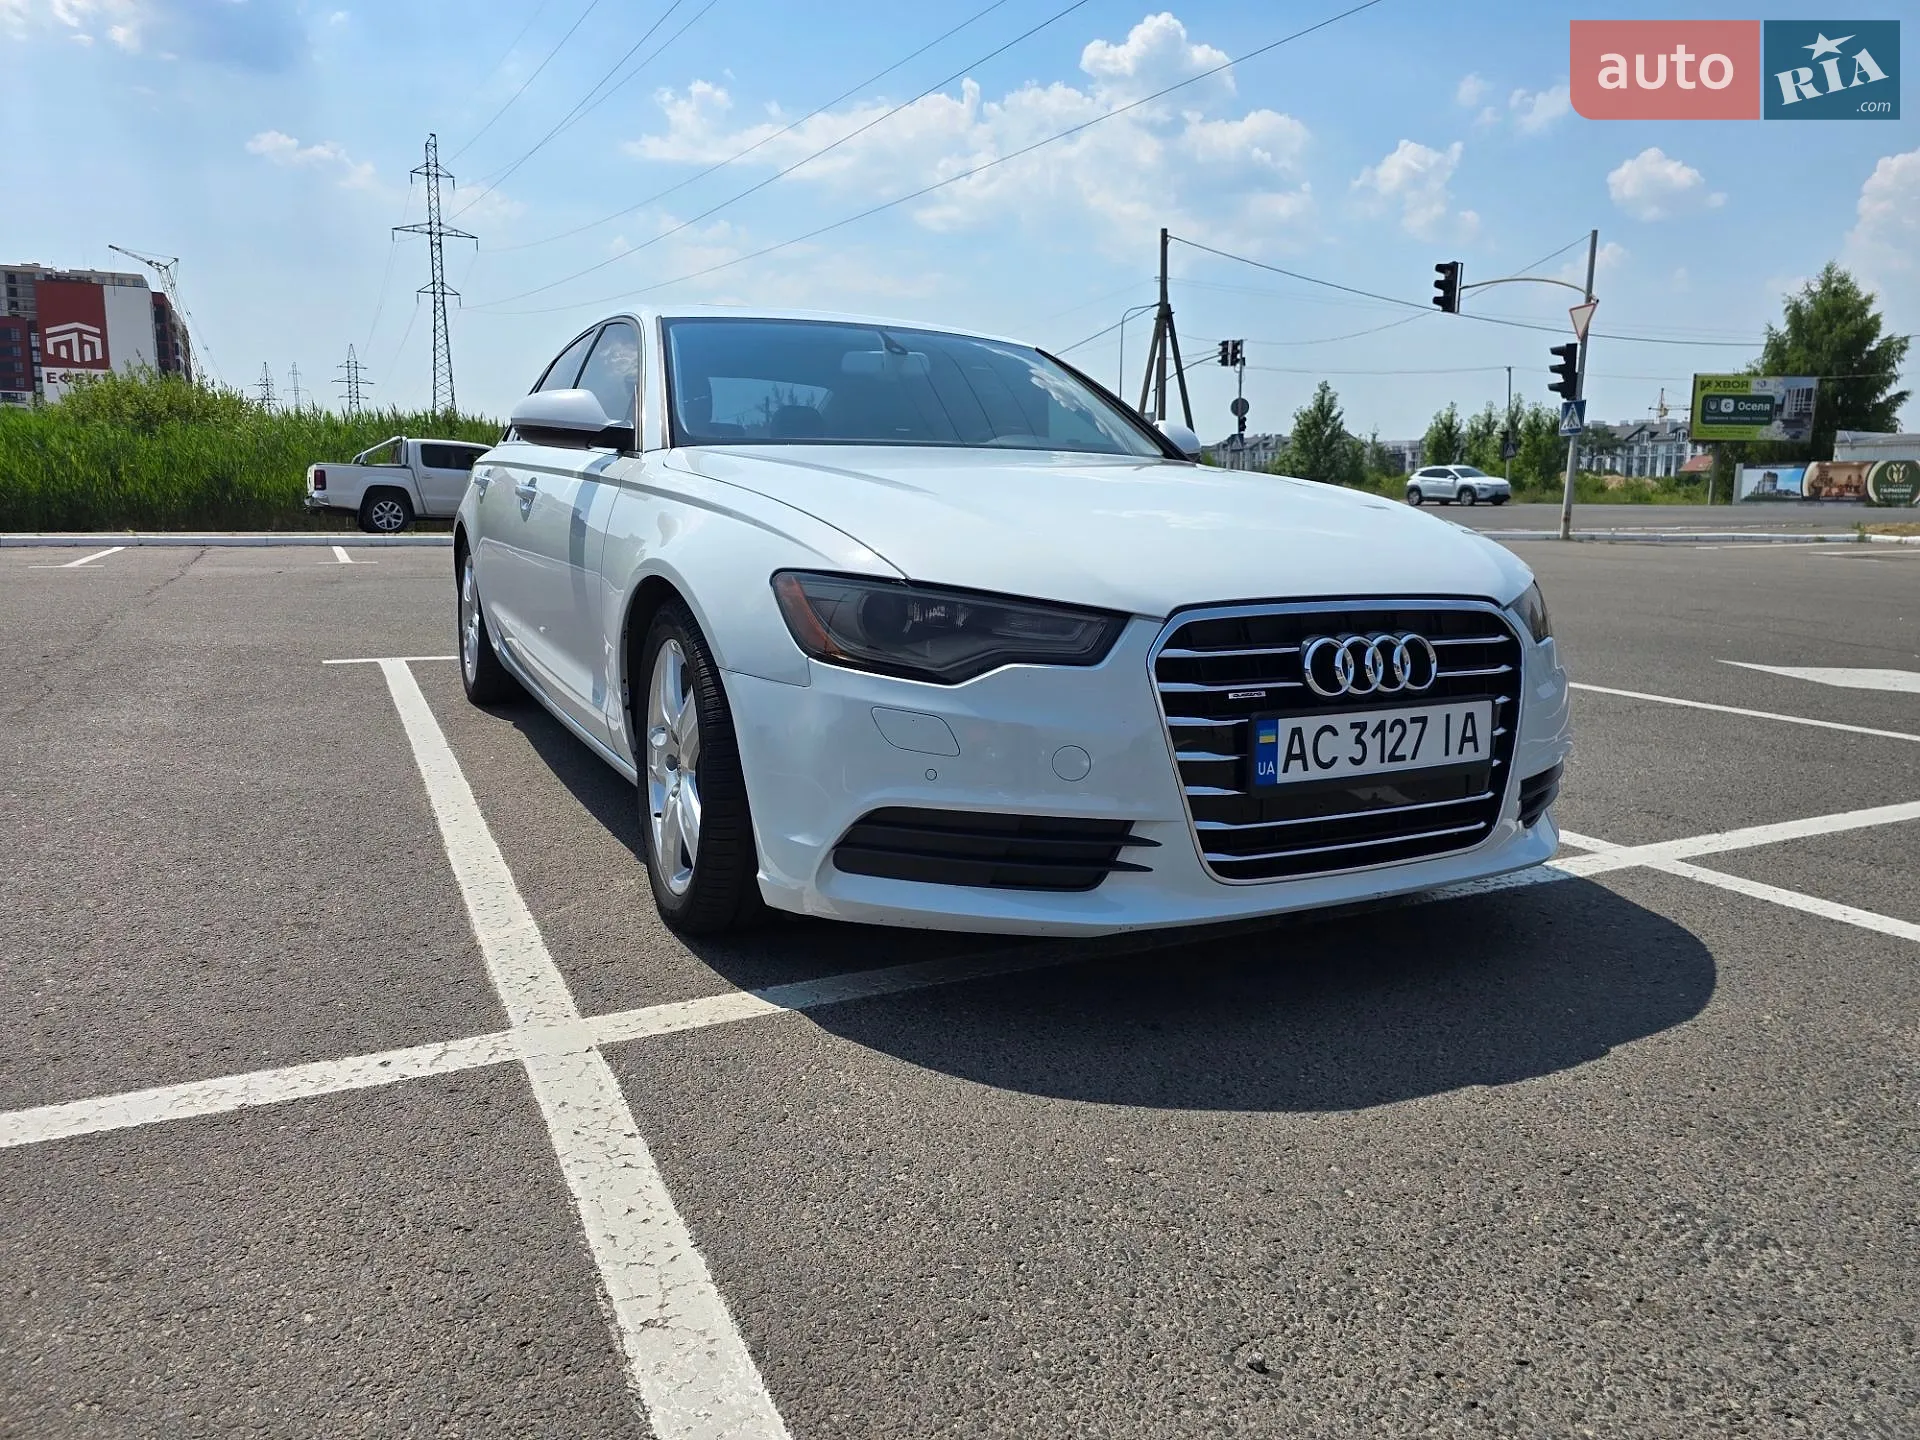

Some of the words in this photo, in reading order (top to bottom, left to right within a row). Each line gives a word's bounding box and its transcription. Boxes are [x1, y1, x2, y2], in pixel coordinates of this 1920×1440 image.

[1714, 380, 1749, 389] ХВОЯ
[1737, 402, 1770, 411] Оселя
[1282, 724, 1339, 774] AC
[1348, 715, 1428, 766] 3127
[1444, 711, 1479, 757] IA
[1258, 761, 1276, 776] UA
